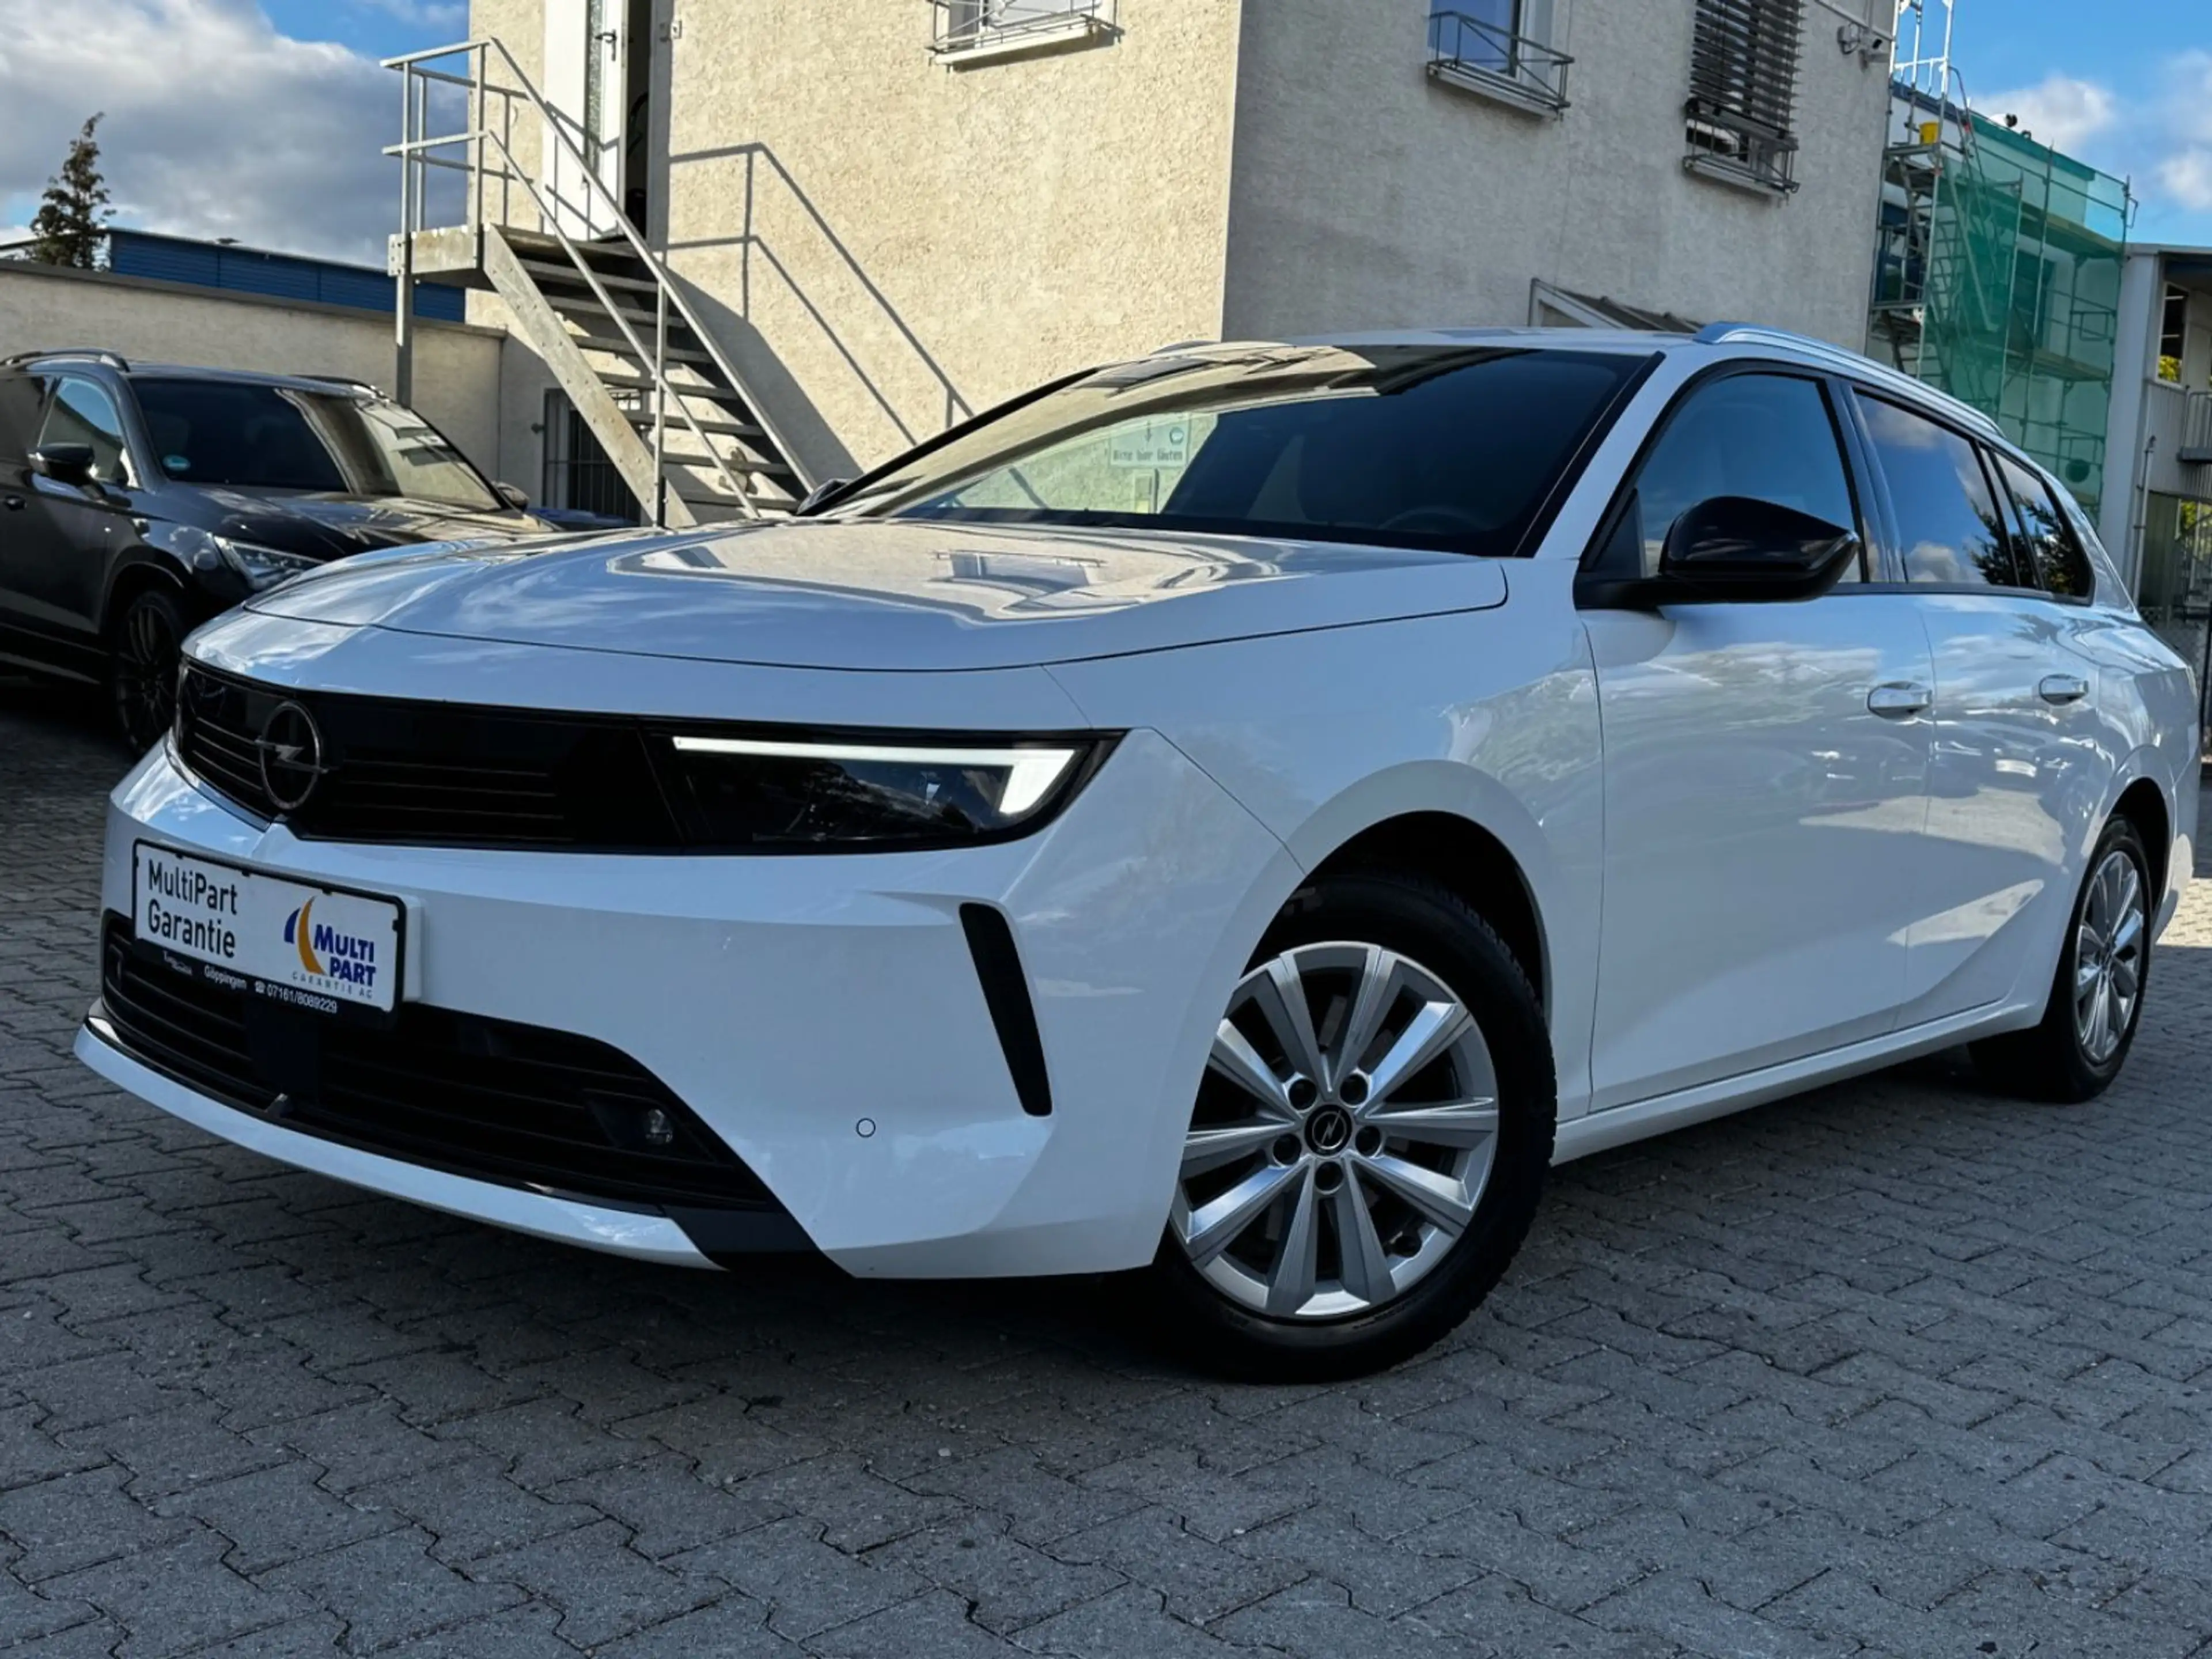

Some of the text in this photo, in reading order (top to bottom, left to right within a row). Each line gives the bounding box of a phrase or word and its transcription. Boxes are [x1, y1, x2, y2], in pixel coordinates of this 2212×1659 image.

[148, 859, 237, 915] MultiPart
[148, 898, 235, 959] Garantie
[314, 924, 374, 963] MULTI
[291, 970, 373, 999] GARANTIE AG
[329, 956, 376, 987] PART
